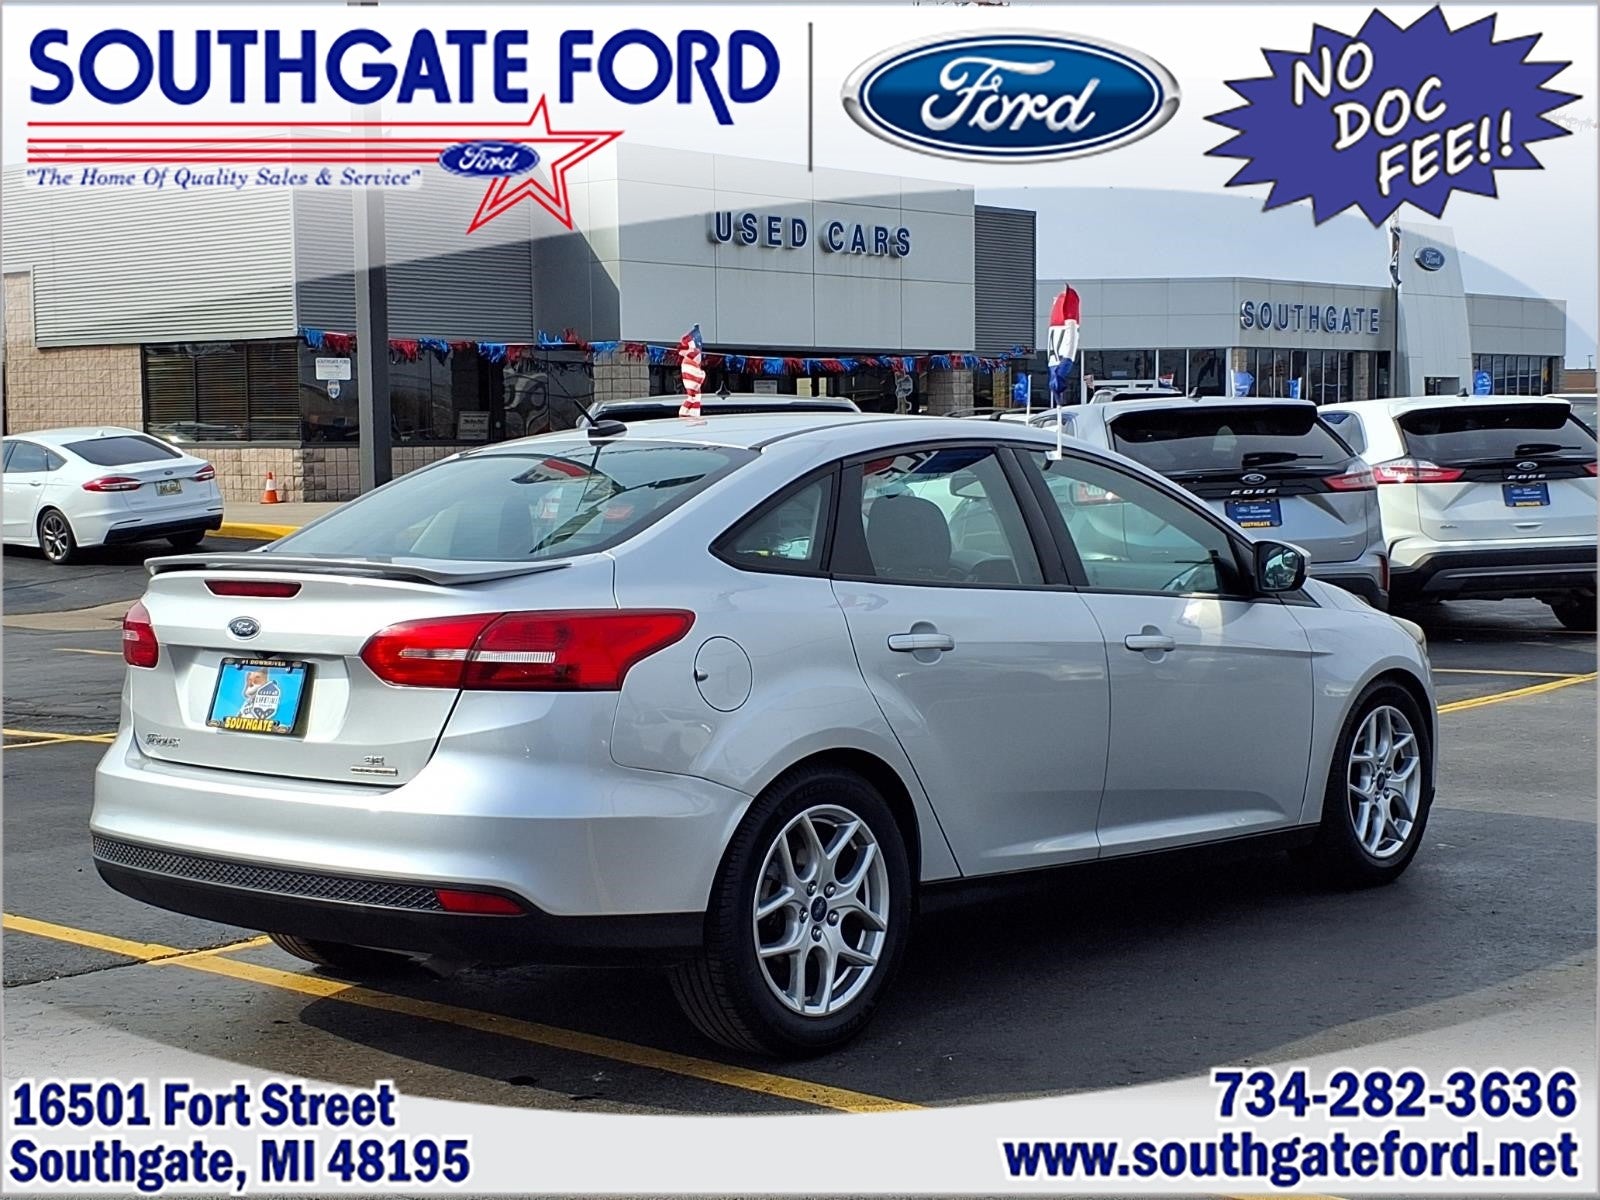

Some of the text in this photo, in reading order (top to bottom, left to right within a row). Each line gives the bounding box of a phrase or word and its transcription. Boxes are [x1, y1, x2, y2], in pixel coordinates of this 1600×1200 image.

[709, 211, 912, 258] USED CARS
[1241, 300, 1379, 333] SOUTHGATE
[224, 717, 274, 731] SOUTHGATE
